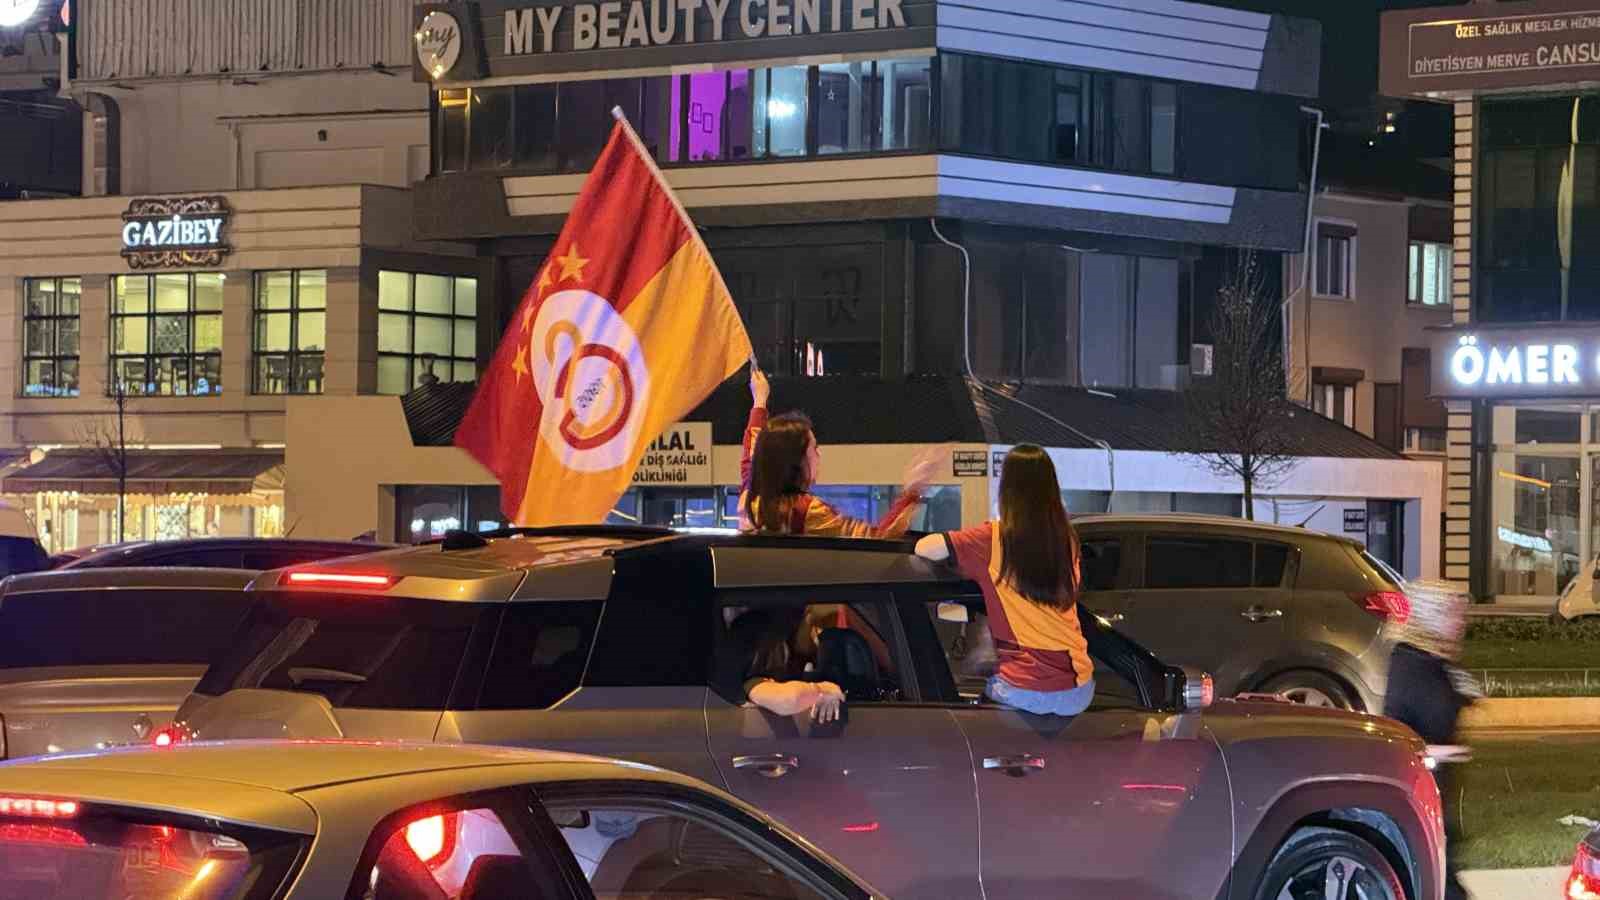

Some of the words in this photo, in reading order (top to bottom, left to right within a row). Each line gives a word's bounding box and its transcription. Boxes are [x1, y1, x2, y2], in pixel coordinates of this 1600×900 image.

[504, 6, 562, 55] MY
[573, 0, 729, 50] BEAUTY
[739, 0, 905, 38] CENTER
[1455, 23, 1481, 38] ÖZEL
[1484, 21, 1522, 36] SAĞLIK
[1524, 18, 1569, 33] MESLEK
[1415, 56, 1482, 73] DİYETİSYEN
[1487, 53, 1530, 68] MERVE
[1536, 42, 1600, 66] CANSU
[122, 214, 222, 246] GAZİBEY
[1452, 335, 1579, 384] ÖMER
[631, 469, 687, 482] OLİKLİNİĞİ
[647, 452, 664, 468] DİŞ
